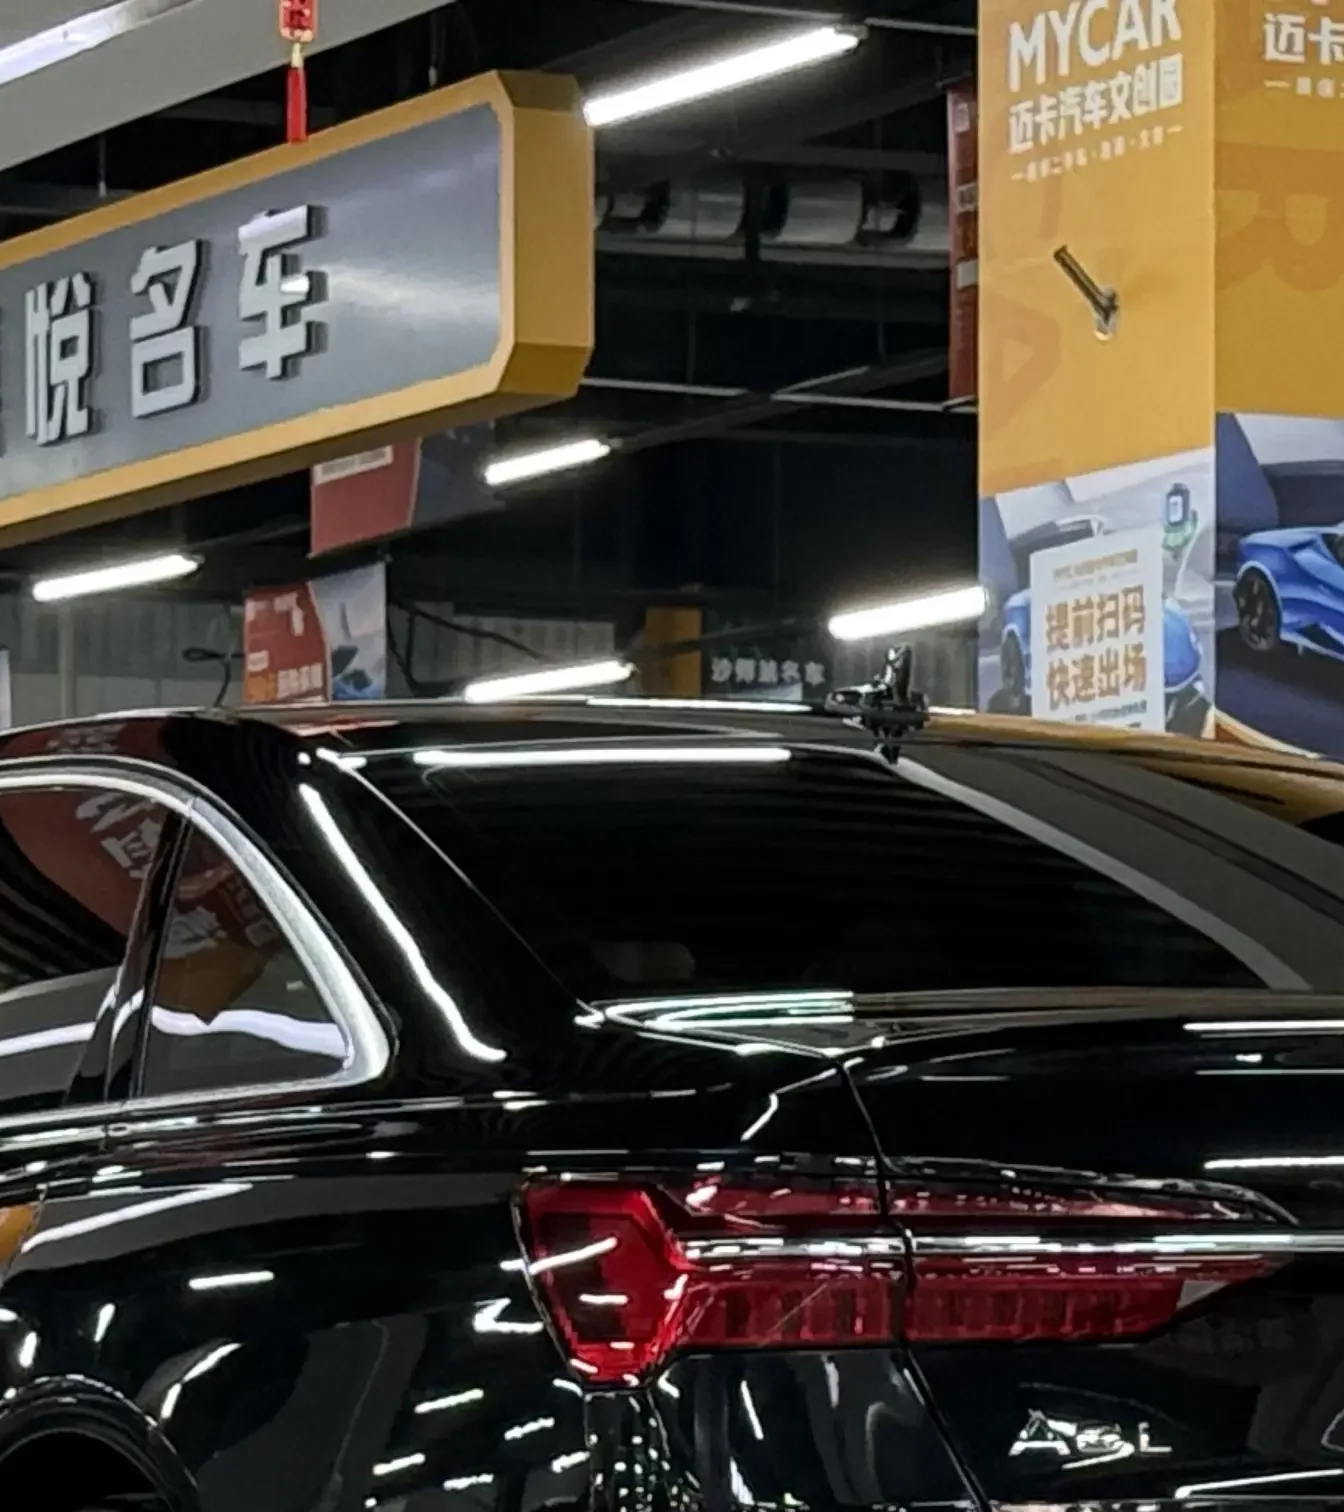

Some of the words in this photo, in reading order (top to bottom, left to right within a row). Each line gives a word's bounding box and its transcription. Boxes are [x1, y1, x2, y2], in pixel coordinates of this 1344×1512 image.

[1009, 0, 1183, 93] MYCAR
[1009, 52, 1184, 154] 迈卡汽车文创园
